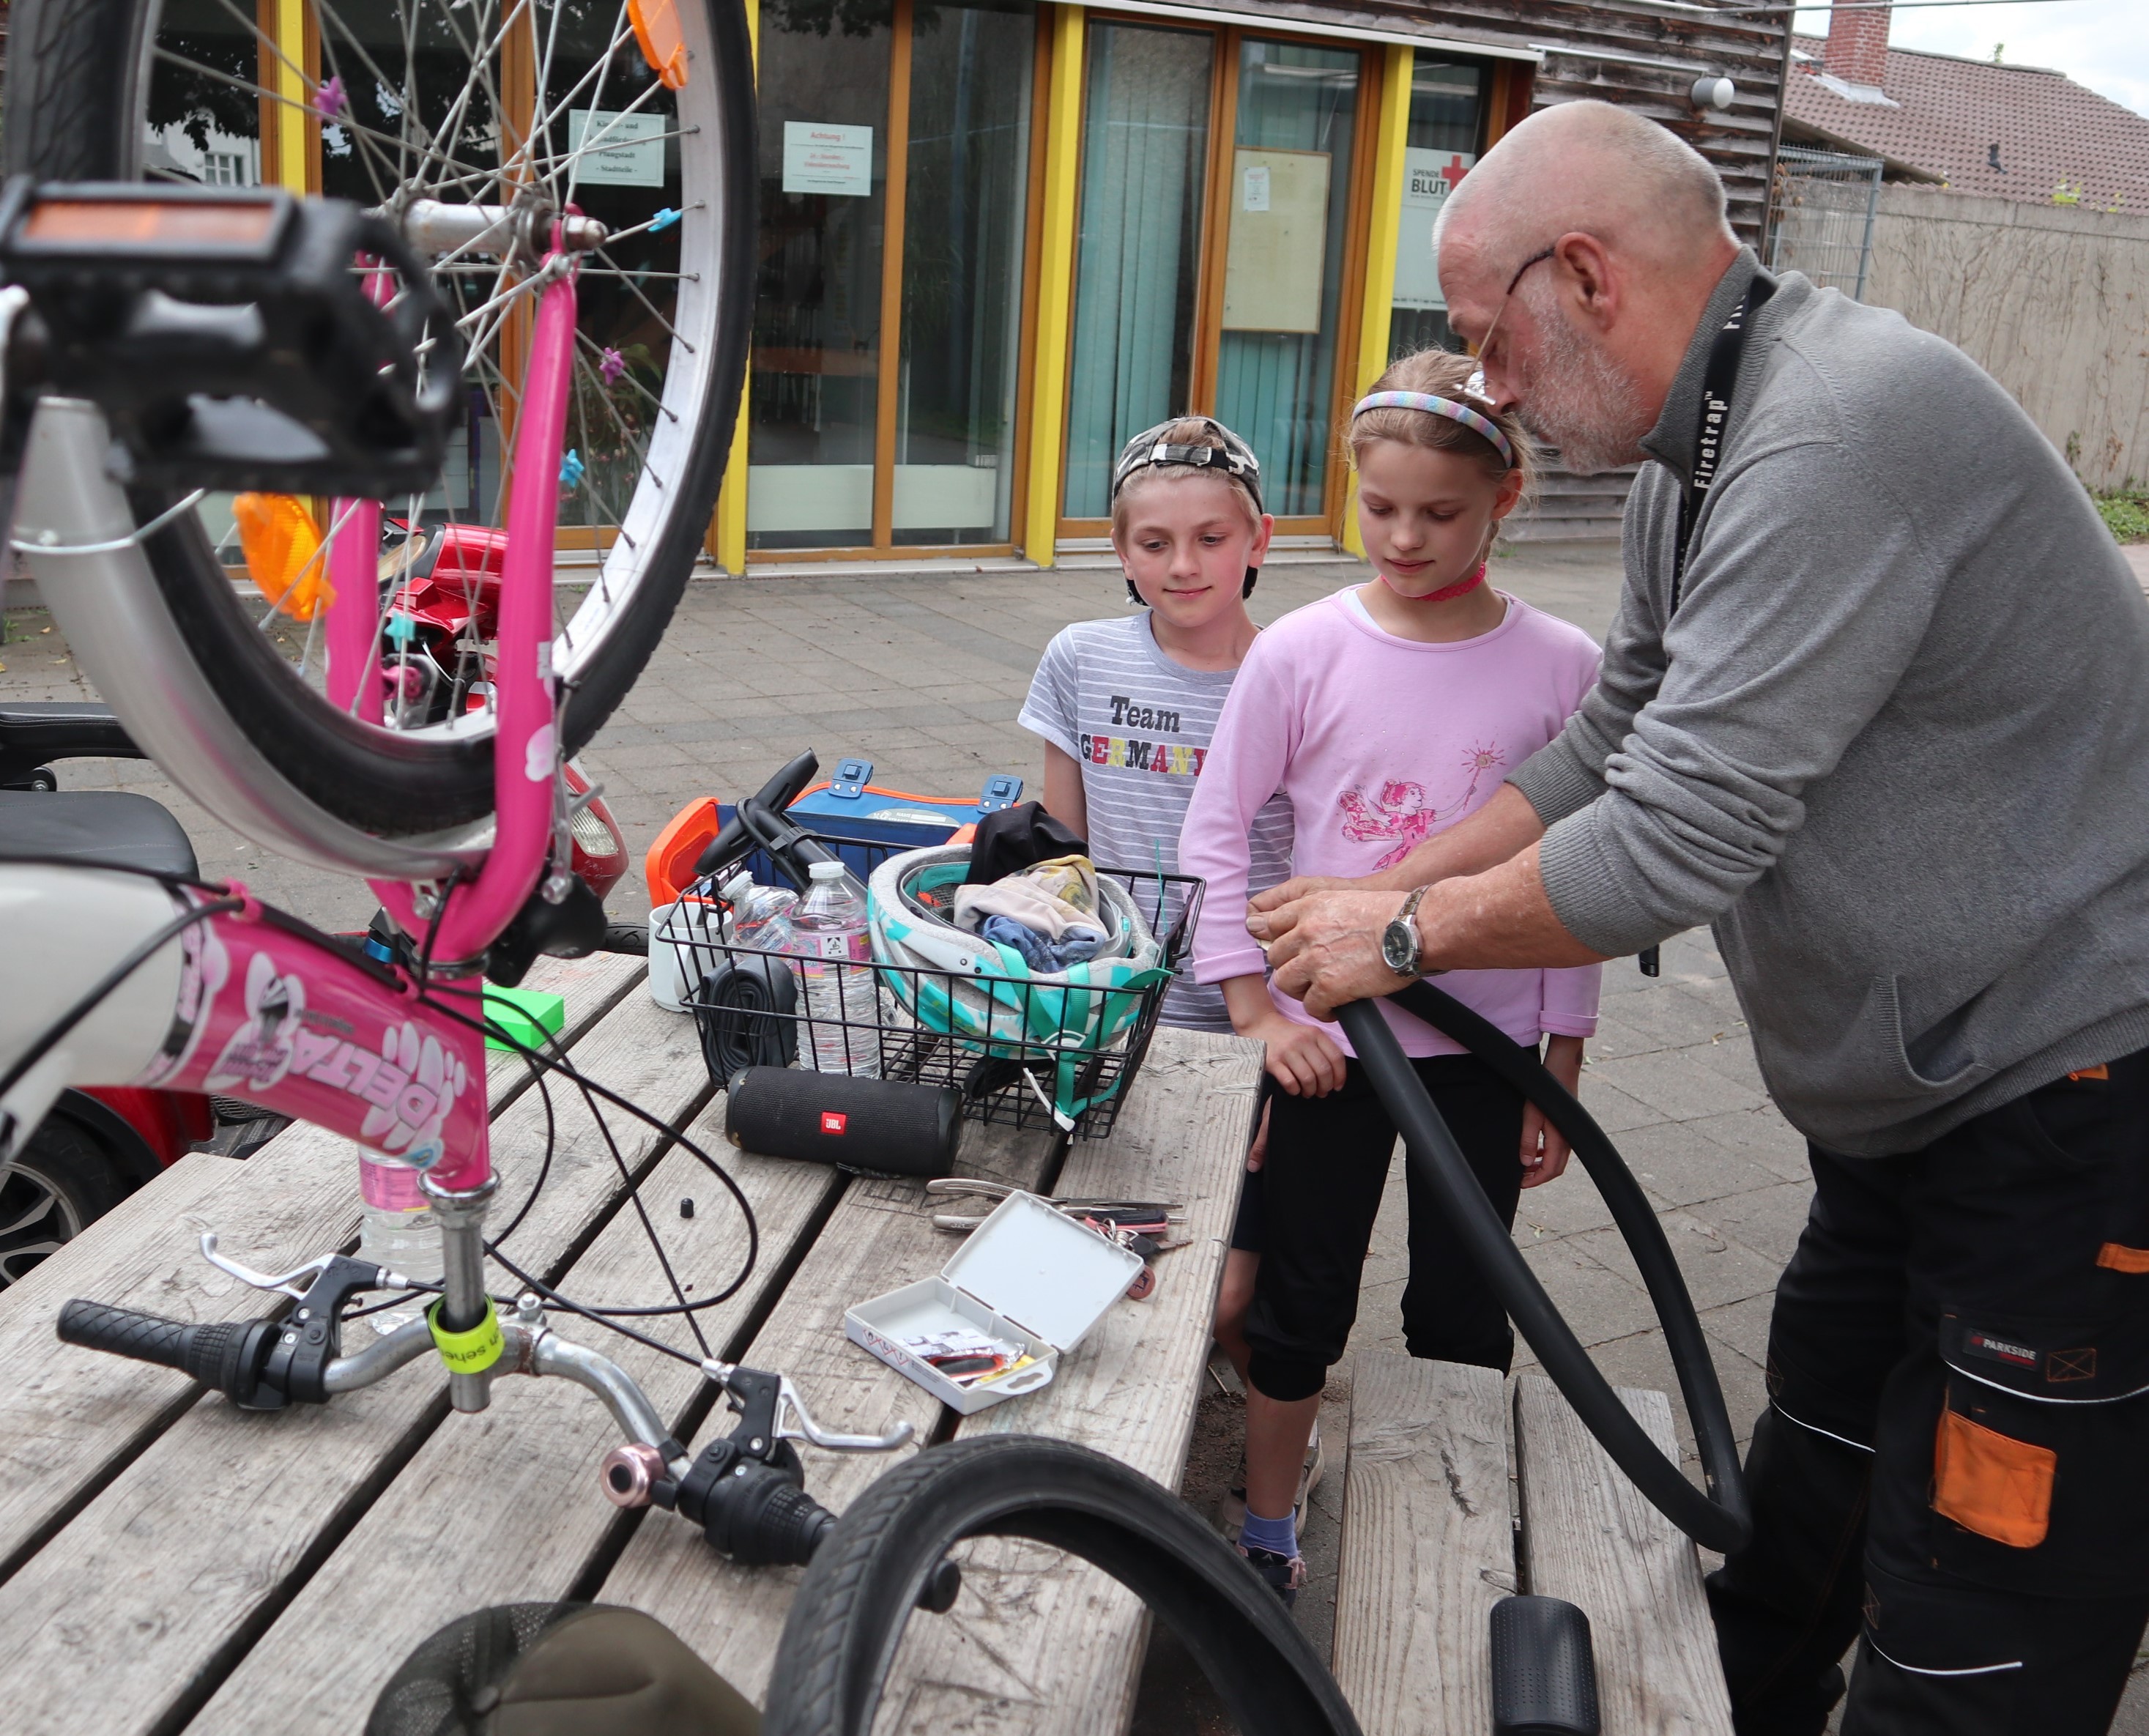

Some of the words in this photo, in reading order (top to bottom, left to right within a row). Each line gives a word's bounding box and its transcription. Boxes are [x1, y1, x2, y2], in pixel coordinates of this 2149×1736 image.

[810, 131, 841, 141] Achtung
[1413, 168, 1439, 178] SPENDE
[1411, 178, 1447, 195] BLUT
[1110, 695, 1180, 732] Team
[287, 1026, 439, 1131] DELTA
[825, 1118, 842, 1130] JBL
[1982, 1338, 2037, 1360] PARKSIDE
